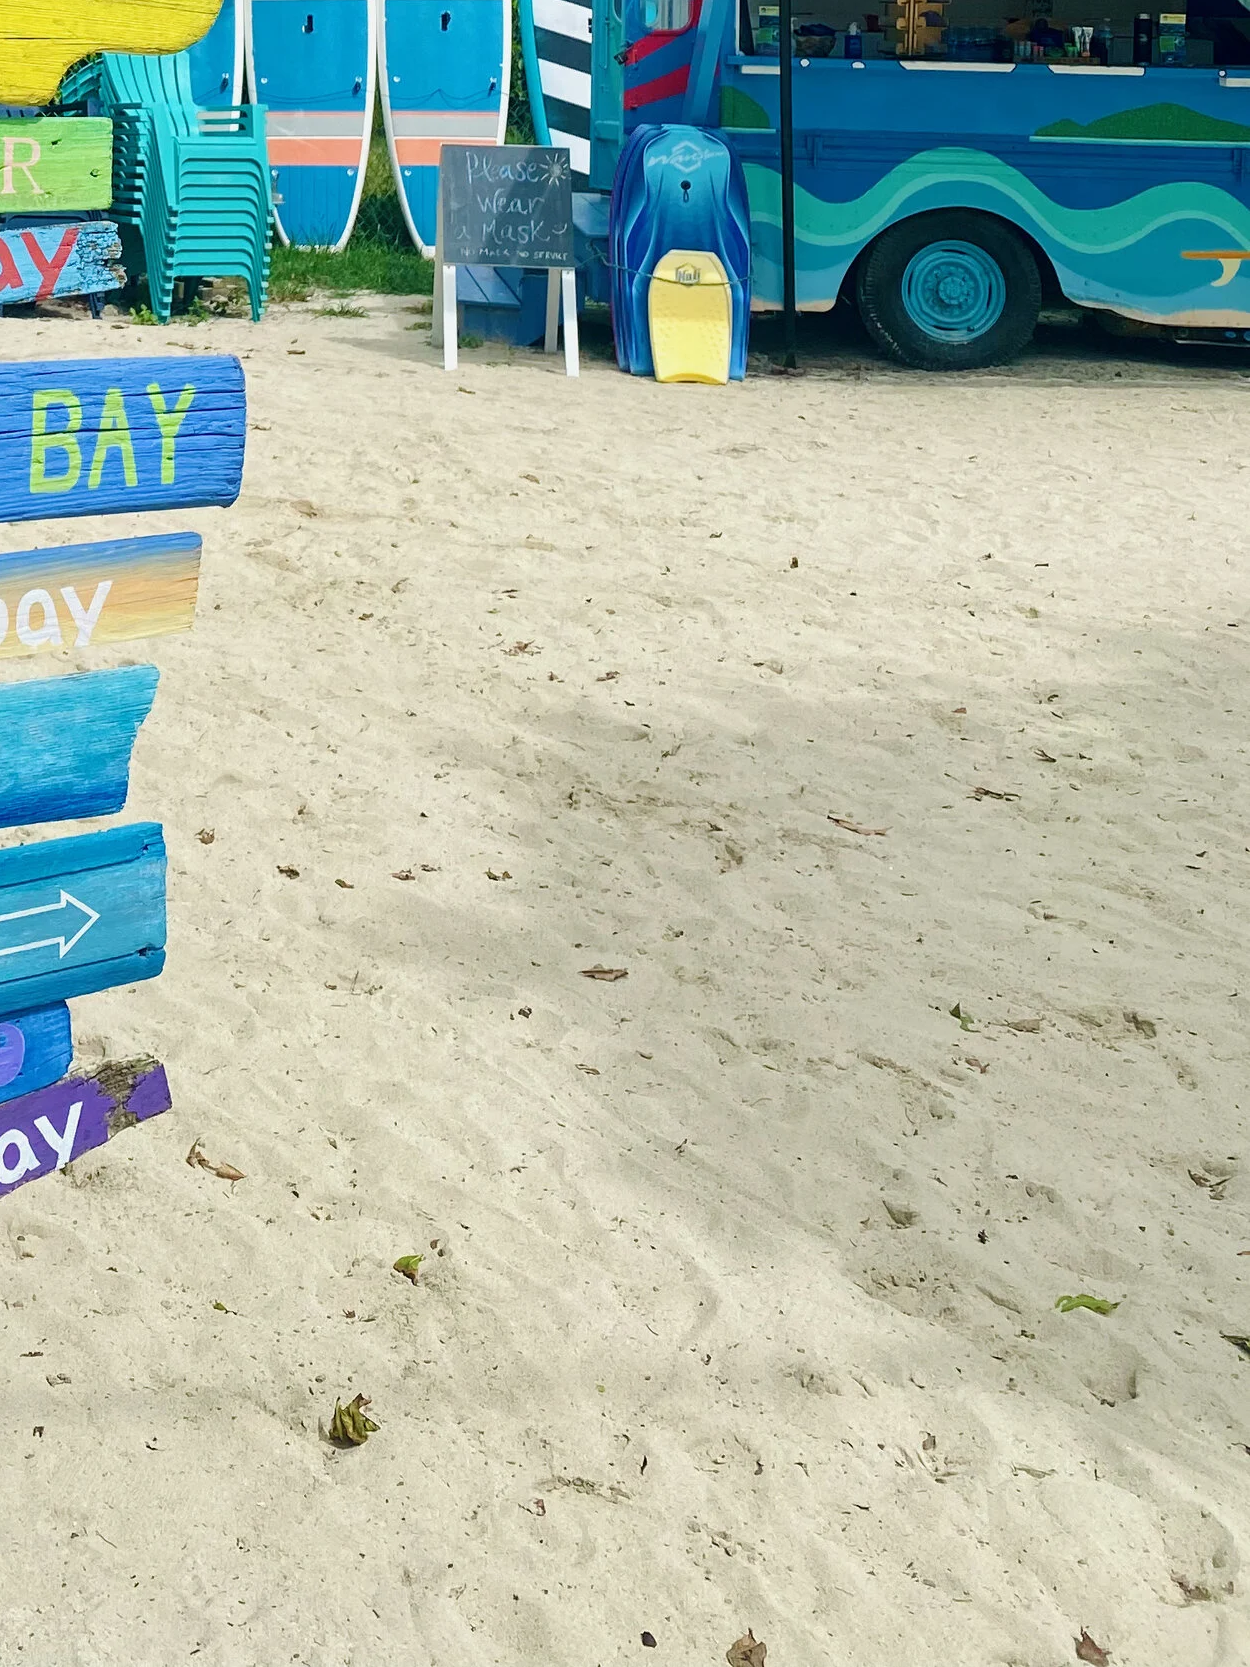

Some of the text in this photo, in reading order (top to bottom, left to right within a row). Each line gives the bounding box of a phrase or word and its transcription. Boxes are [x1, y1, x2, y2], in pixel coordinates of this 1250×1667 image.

[465, 151, 540, 185] Please
[476, 187, 546, 215] Wear
[29, 381, 198, 494] BAY
